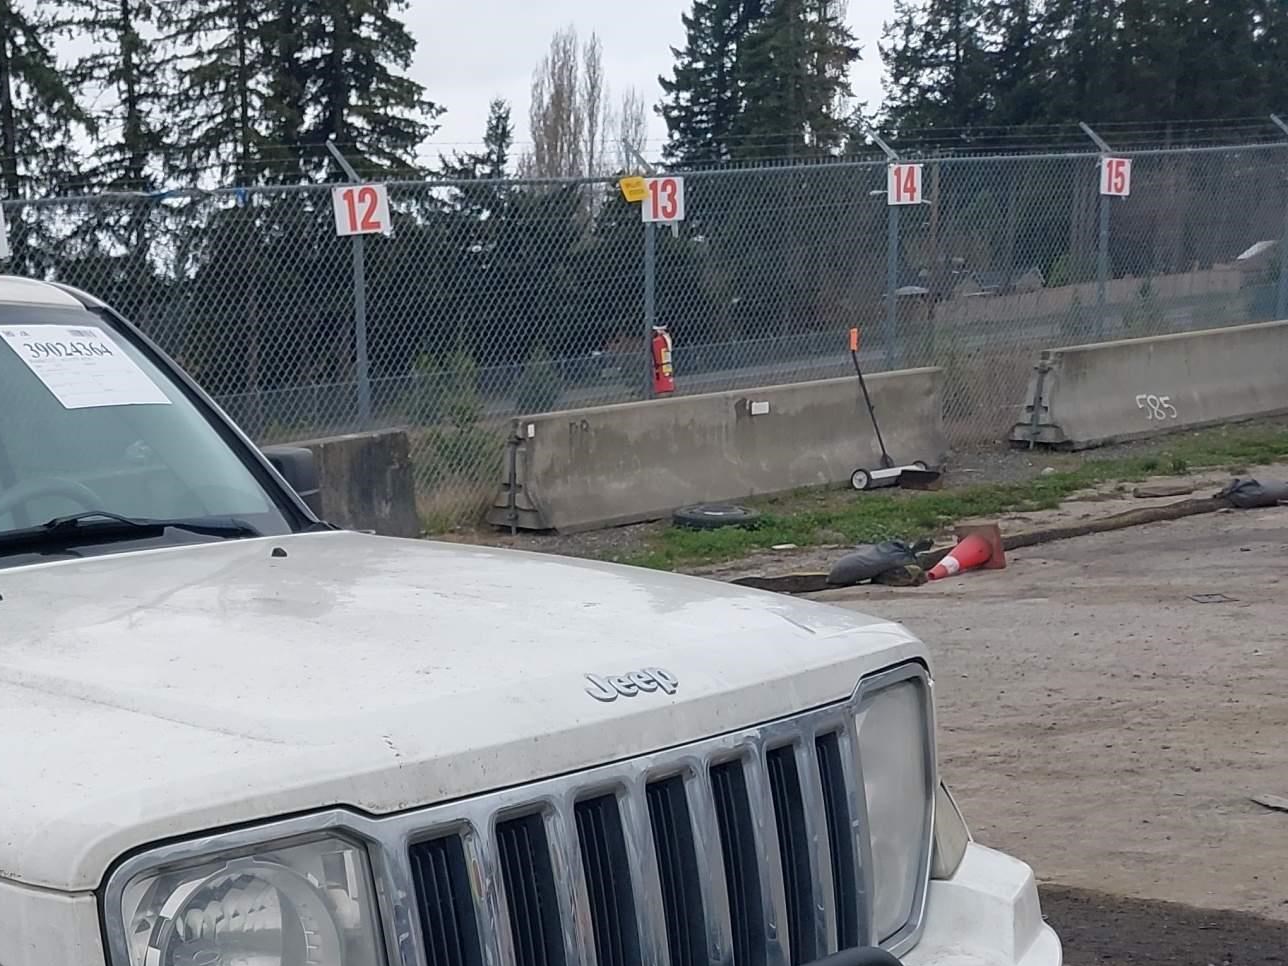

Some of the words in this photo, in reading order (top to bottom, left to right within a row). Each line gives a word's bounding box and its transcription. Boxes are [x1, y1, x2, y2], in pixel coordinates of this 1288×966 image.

[894, 166, 917, 202] 14
[1107, 159, 1126, 193] 15
[344, 187, 380, 231] 12
[649, 179, 677, 219] 13
[23, 342, 113, 358] 39024364
[1136, 395, 1177, 420] 585
[584, 667, 679, 702] Jeep
